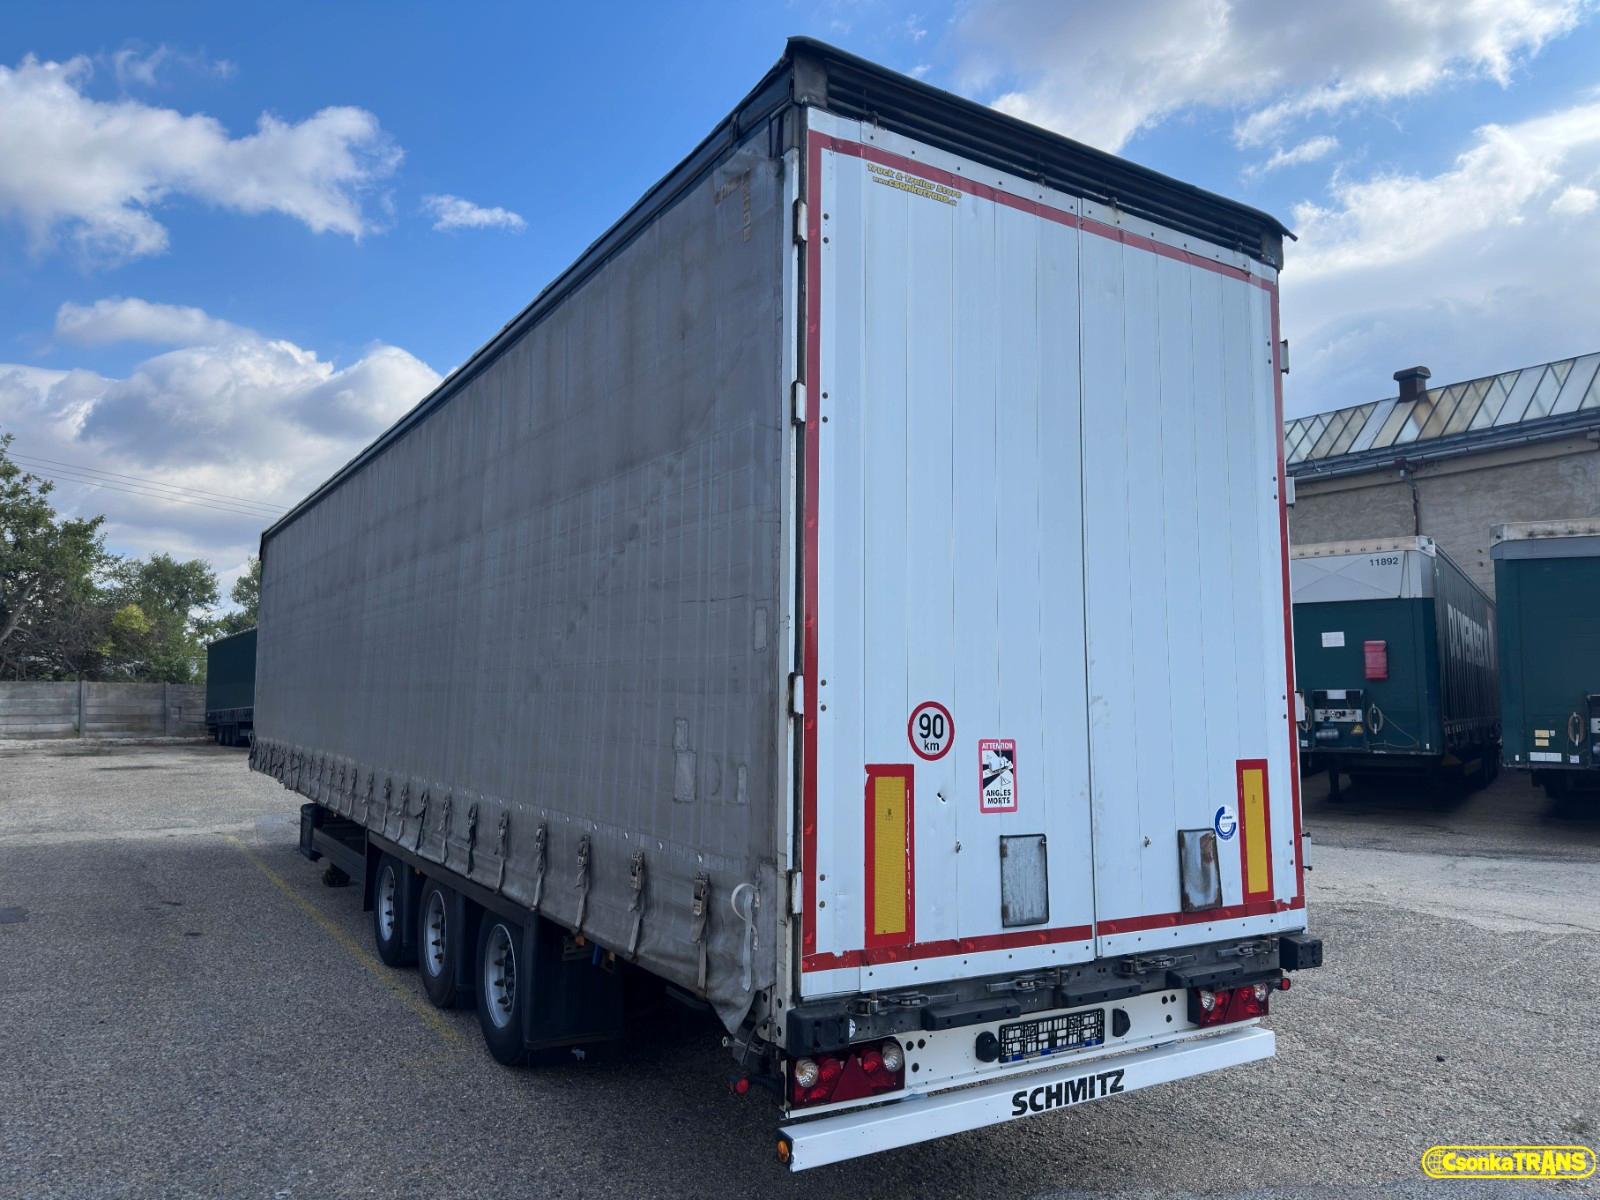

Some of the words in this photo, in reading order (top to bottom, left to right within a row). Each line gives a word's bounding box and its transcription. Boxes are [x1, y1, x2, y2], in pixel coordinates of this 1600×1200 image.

[1369, 557, 1399, 567] 11892
[919, 713, 944, 739] 90
[924, 740, 940, 751] km
[982, 742, 1013, 750] ATTENTION
[986, 789, 1012, 797] ANGLES
[987, 797, 1011, 805] MORTS
[1011, 1068, 1125, 1116] SCHMITZ
